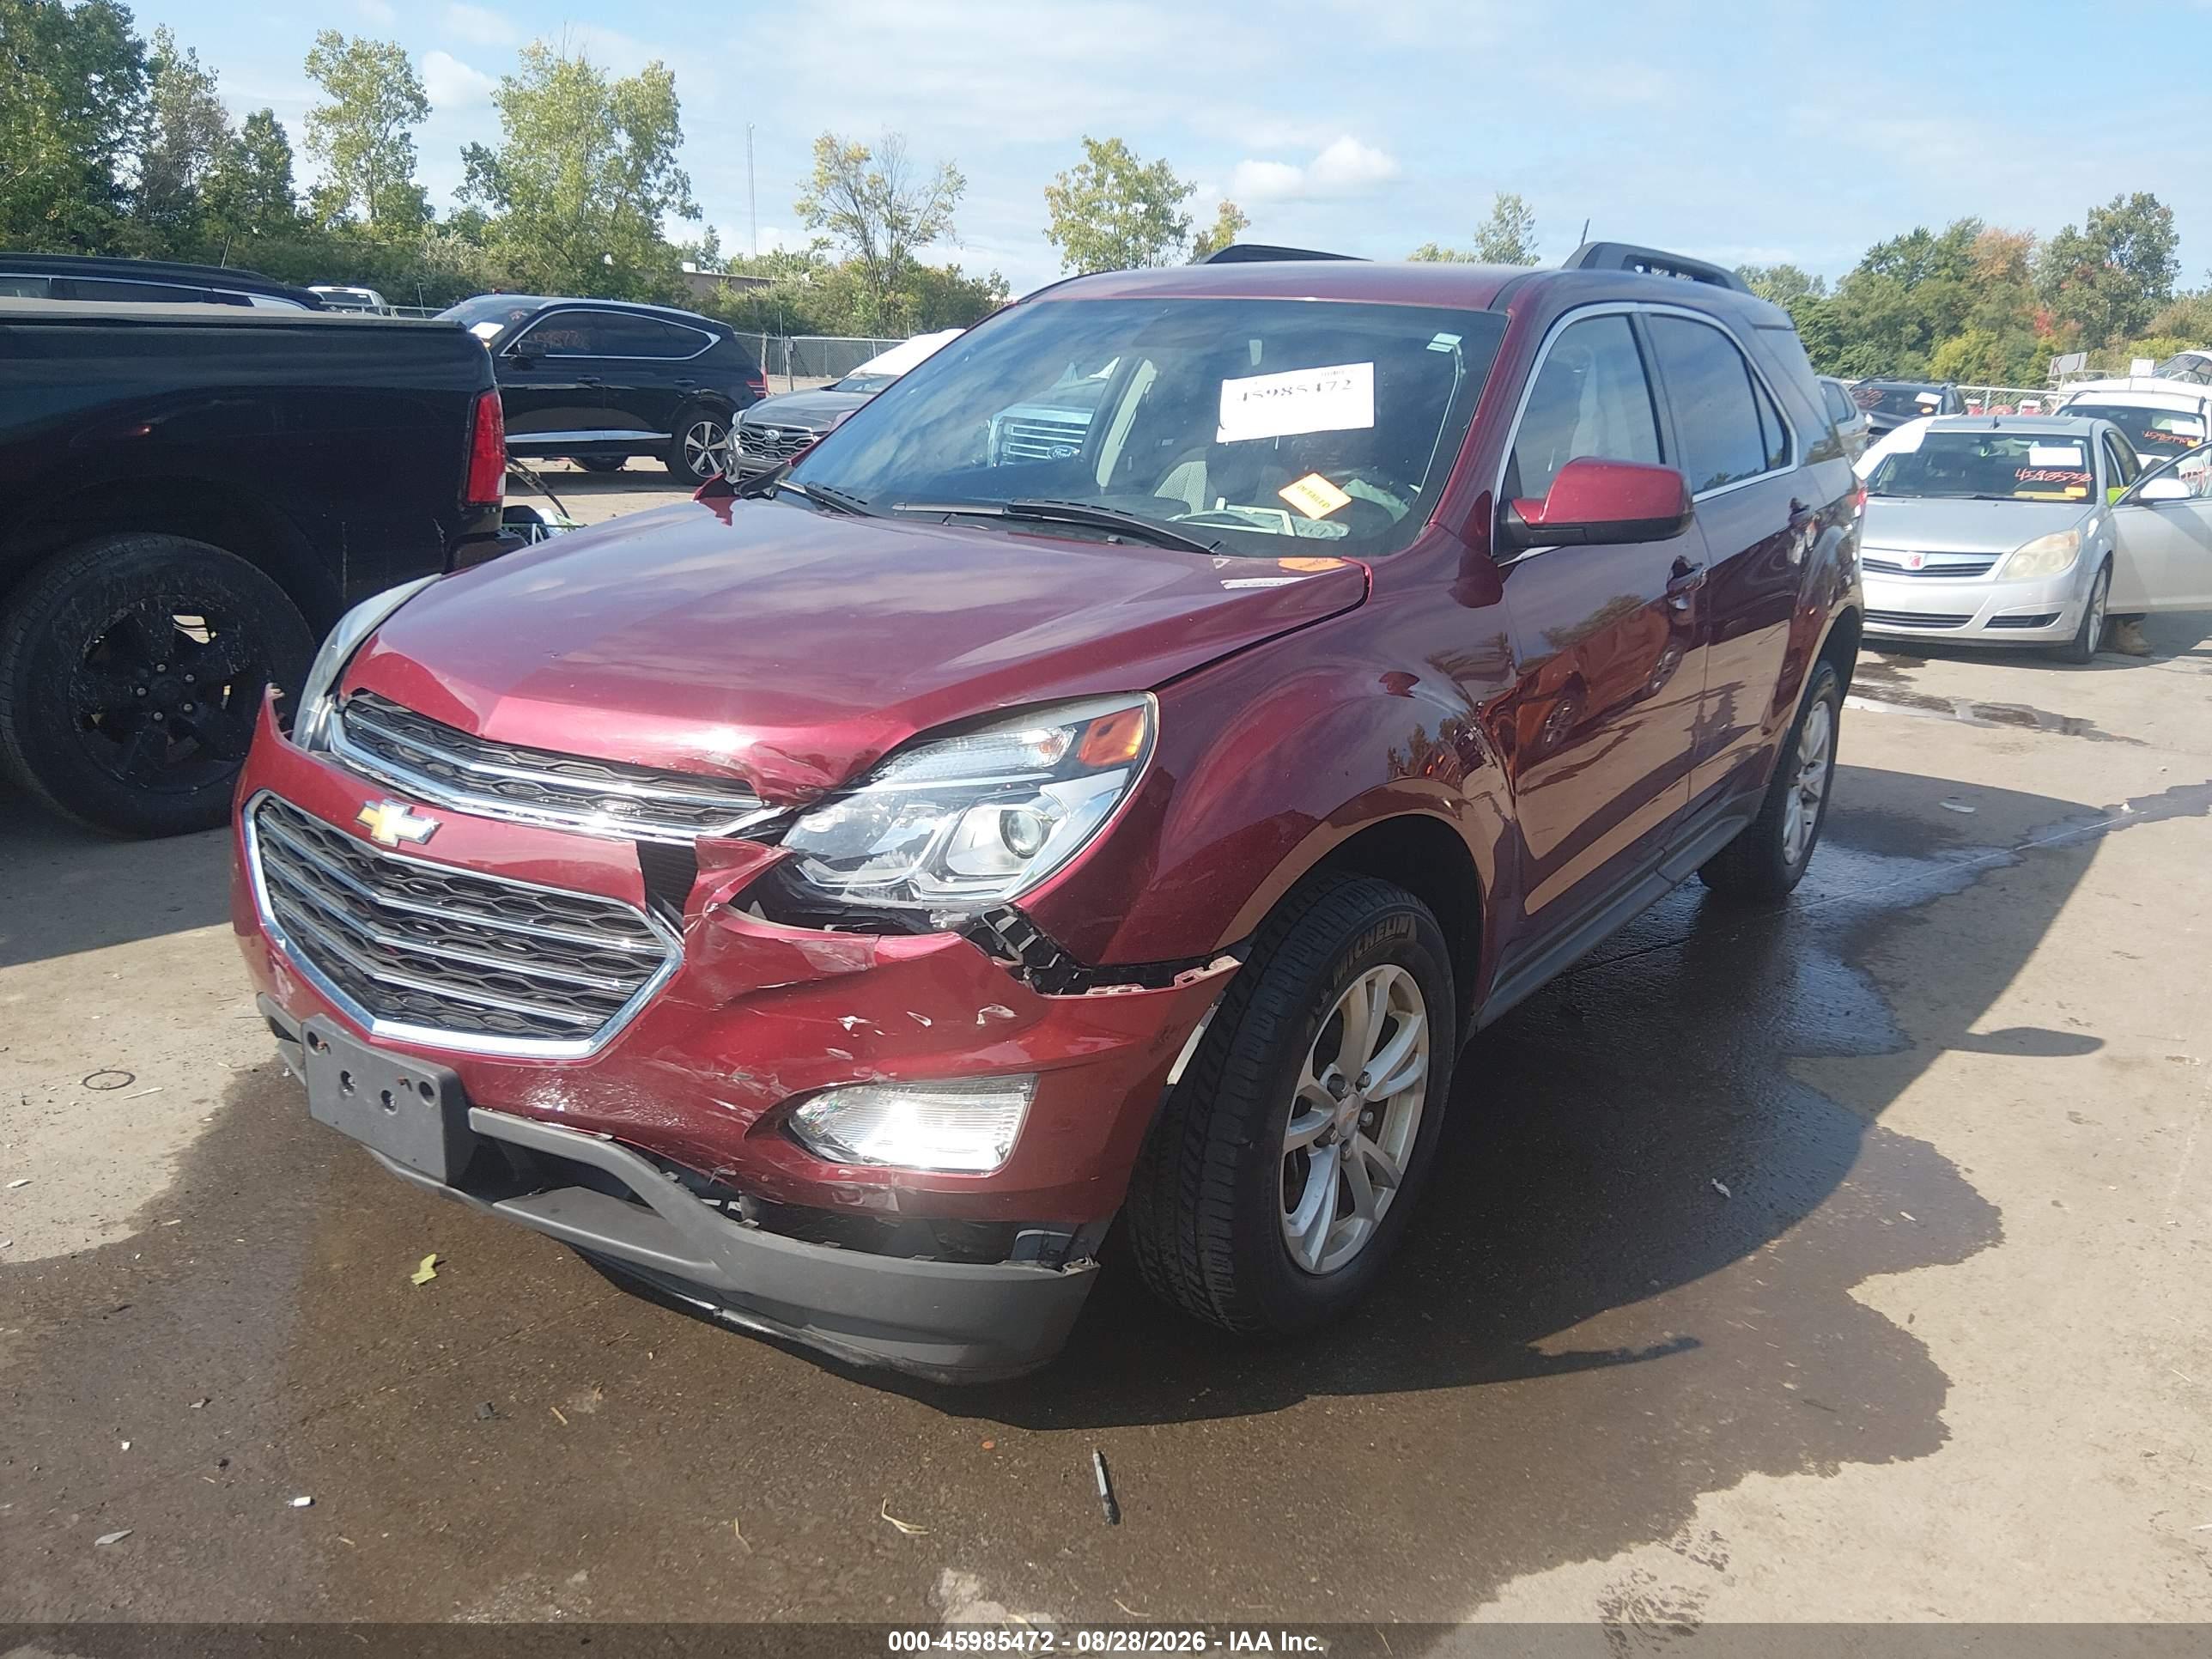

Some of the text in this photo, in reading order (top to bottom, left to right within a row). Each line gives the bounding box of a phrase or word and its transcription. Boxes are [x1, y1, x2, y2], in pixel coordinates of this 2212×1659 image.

[2051, 353, 2082, 374] K J
[1052, 447, 1073, 459] Ford
[1297, 483, 1331, 509] DETAILED
[1333, 914, 1411, 988] MICHELIN
